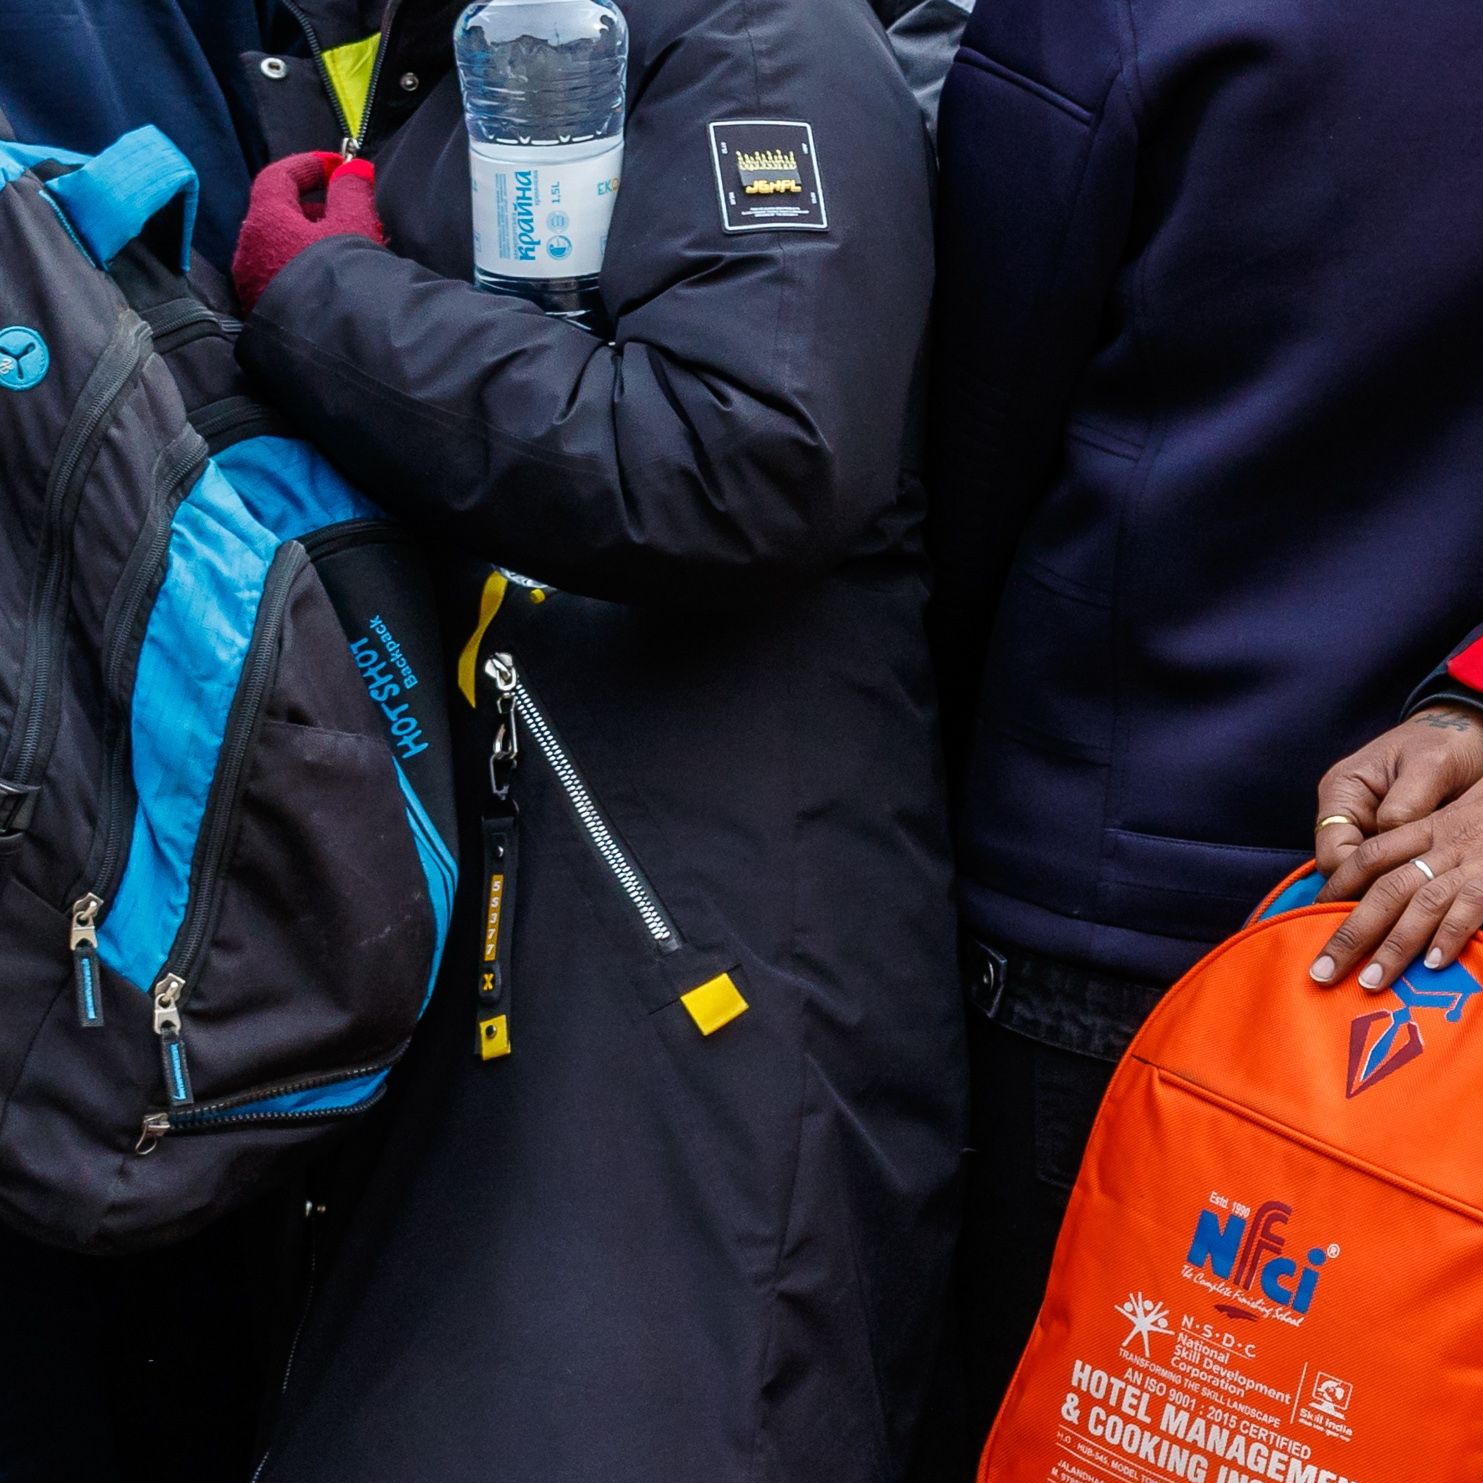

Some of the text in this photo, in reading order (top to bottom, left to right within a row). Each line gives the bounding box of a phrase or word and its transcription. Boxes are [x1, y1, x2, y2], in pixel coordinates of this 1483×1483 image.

[369, 614, 419, 690] Backpack
[1193, 1273, 1233, 1298] Complete
[1232, 1290, 1274, 1318] Finishing
[1272, 1307, 1305, 1328] School
[1174, 1344, 1292, 1405] Skill Development
[1177, 1332, 1230, 1364] National
[1071, 1359, 1152, 1425] HOTEL
[1119, 1347, 1281, 1428] TRANSFORMING THE SKILL LANDSCAPE
[1170, 1356, 1245, 1398] Corporation
[1060, 1391, 1081, 1425] &
[1124, 1367, 1143, 1386] AN
[1144, 1375, 1167, 1397] ISO
[1168, 1389, 1197, 1412] 9001
[1206, 1406, 1238, 1429] 2015
[1239, 1420, 1312, 1460] CERTIFIED
[1299, 1407, 1324, 1424] Skill
[1325, 1418, 1353, 1436] India
[1110, 1459, 1139, 1481] MODEL
